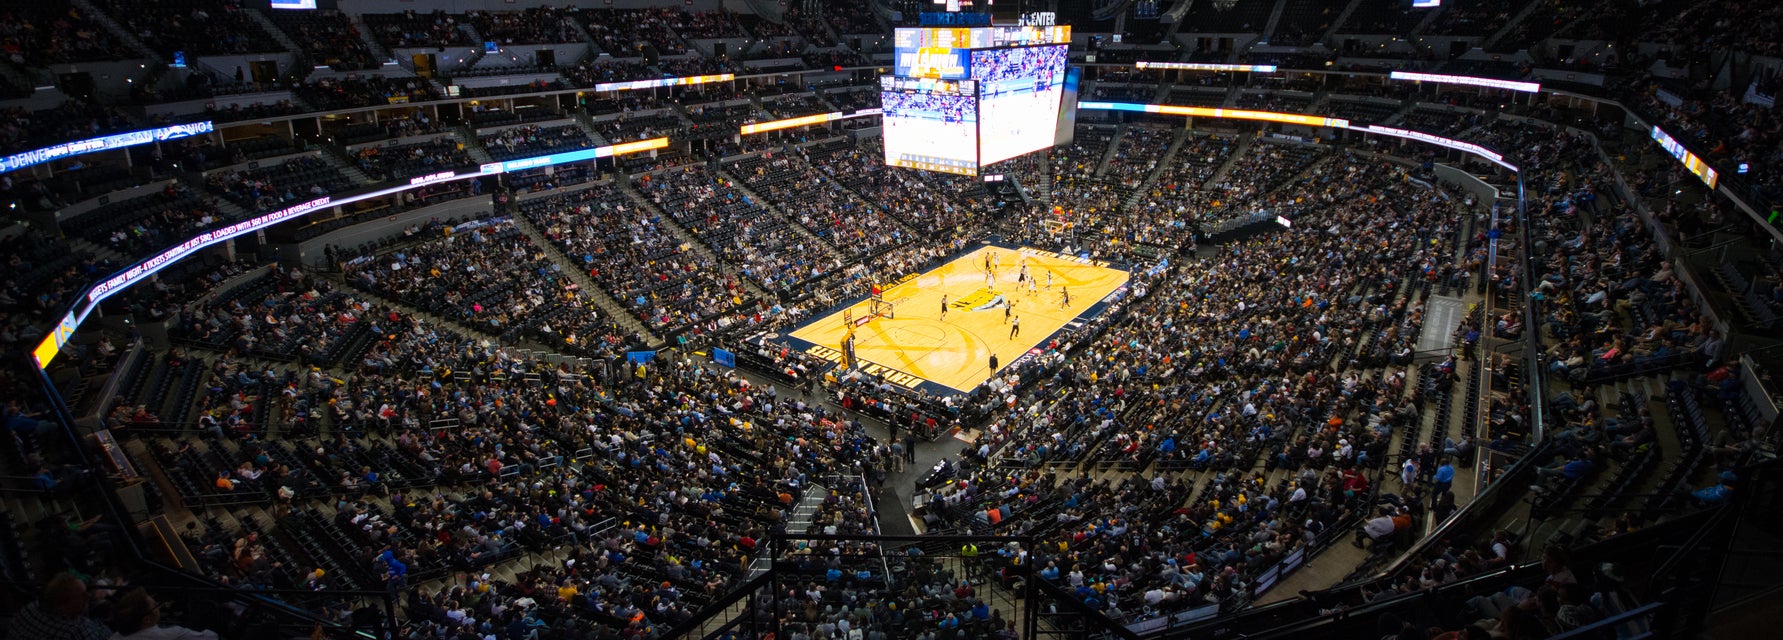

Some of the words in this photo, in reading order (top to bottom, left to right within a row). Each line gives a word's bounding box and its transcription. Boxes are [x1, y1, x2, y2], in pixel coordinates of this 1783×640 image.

[157, 122, 206, 140] ANONIO
[107, 272, 126, 289] FAMILY
[147, 255, 165, 270] TICKETS
[165, 245, 185, 260] STARTING
[212, 224, 236, 239] LOADED
[236, 219, 252, 232] WITH
[268, 210, 283, 222] FOOD
[287, 201, 312, 215] BEVERAGE
[311, 196, 330, 208] CREDIT
